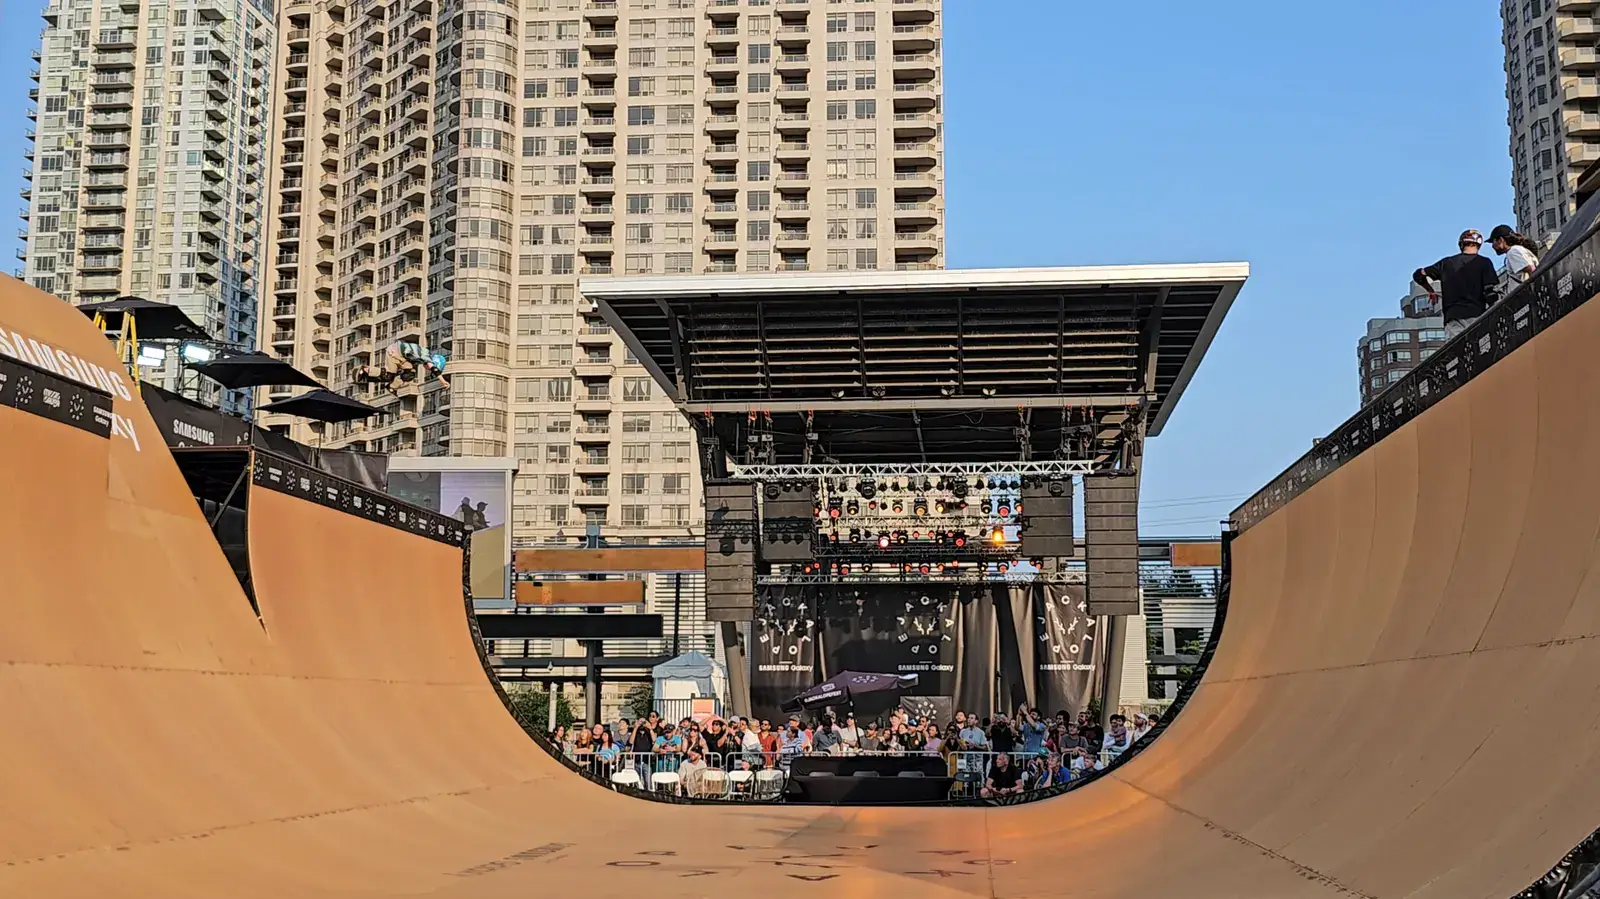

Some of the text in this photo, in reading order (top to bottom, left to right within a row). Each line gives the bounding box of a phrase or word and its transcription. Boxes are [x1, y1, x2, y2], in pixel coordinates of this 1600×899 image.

[0, 327, 131, 401] SAMSUNG
[173, 419, 215, 445] SAMSUNG
[790, 664, 813, 672] Galaxy
[930, 664, 954, 672] Galaxy
[1072, 664, 1096, 672] Galaxy
